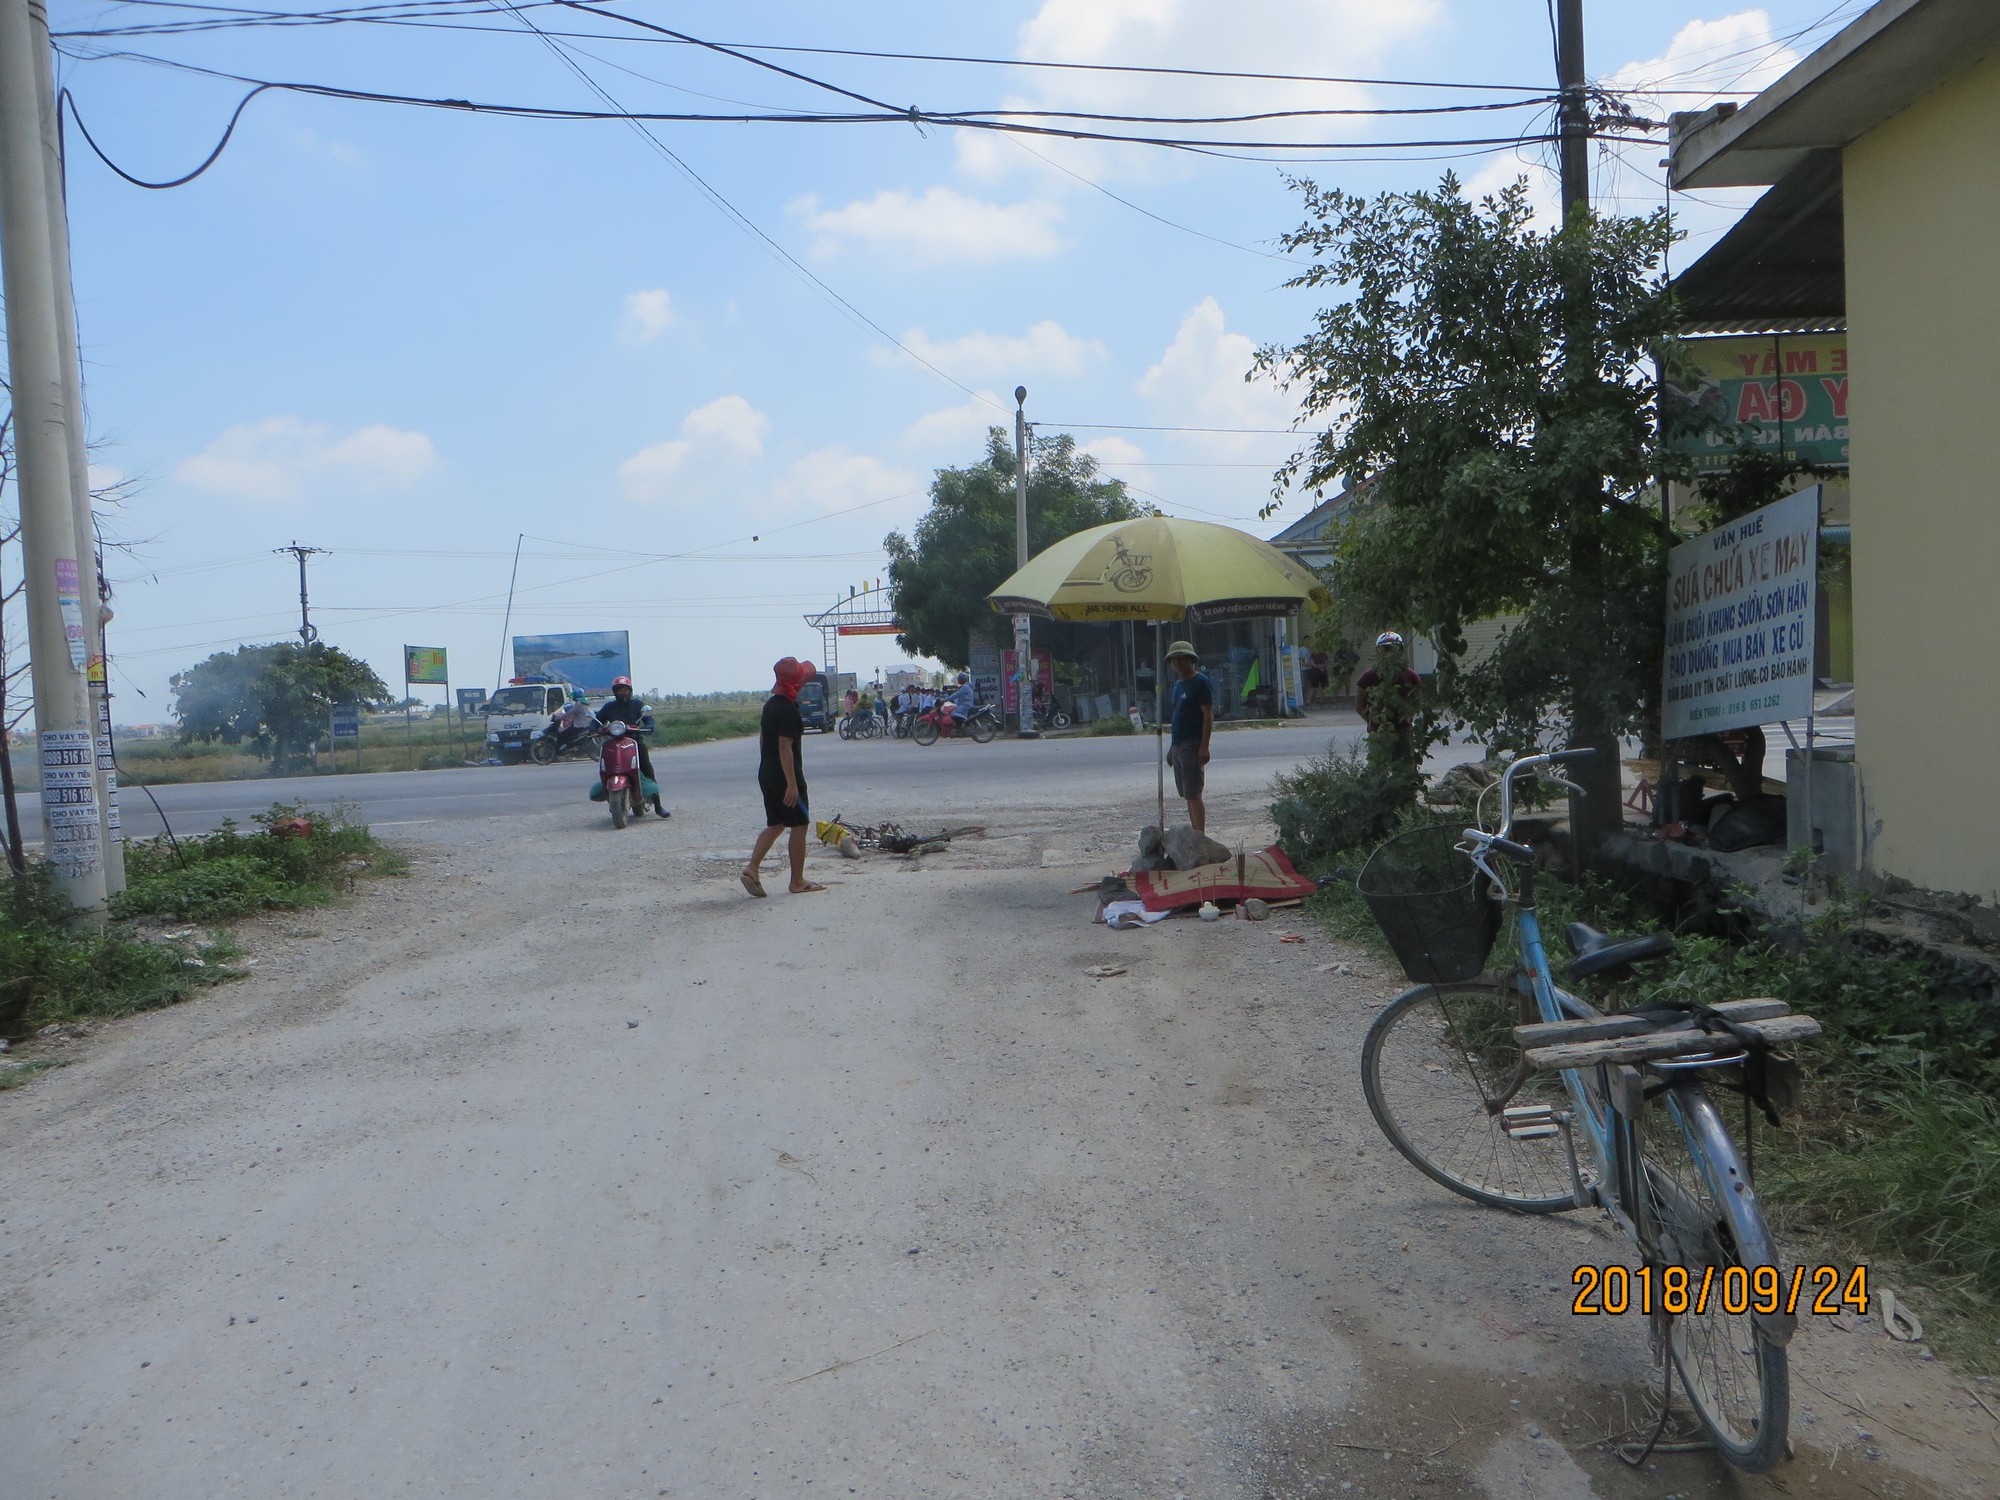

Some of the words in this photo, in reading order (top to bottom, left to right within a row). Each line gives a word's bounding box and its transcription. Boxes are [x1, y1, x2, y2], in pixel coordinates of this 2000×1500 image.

[1713, 528, 1735, 551] VĂN
[1748, 542, 1771, 585] XE
[1130, 604, 1150, 613] ALL
[1707, 604, 1736, 638] KHUNG
[1786, 578, 1809, 613] HÀN
[1722, 637, 1742, 665] MUA
[1745, 626, 1766, 662] BÁN
[1771, 625, 1786, 656] XE
[1789, 614, 1805, 650] CŨ
[1786, 655, 1808, 678] HÀNH
[60, 733, 75, 741] VAY
[62, 748, 79, 765] 516
[58, 771, 75, 779] VAY
[62, 787, 79, 803] 516
[79, 786, 93, 803] 190
[69, 809, 84, 817] VAY
